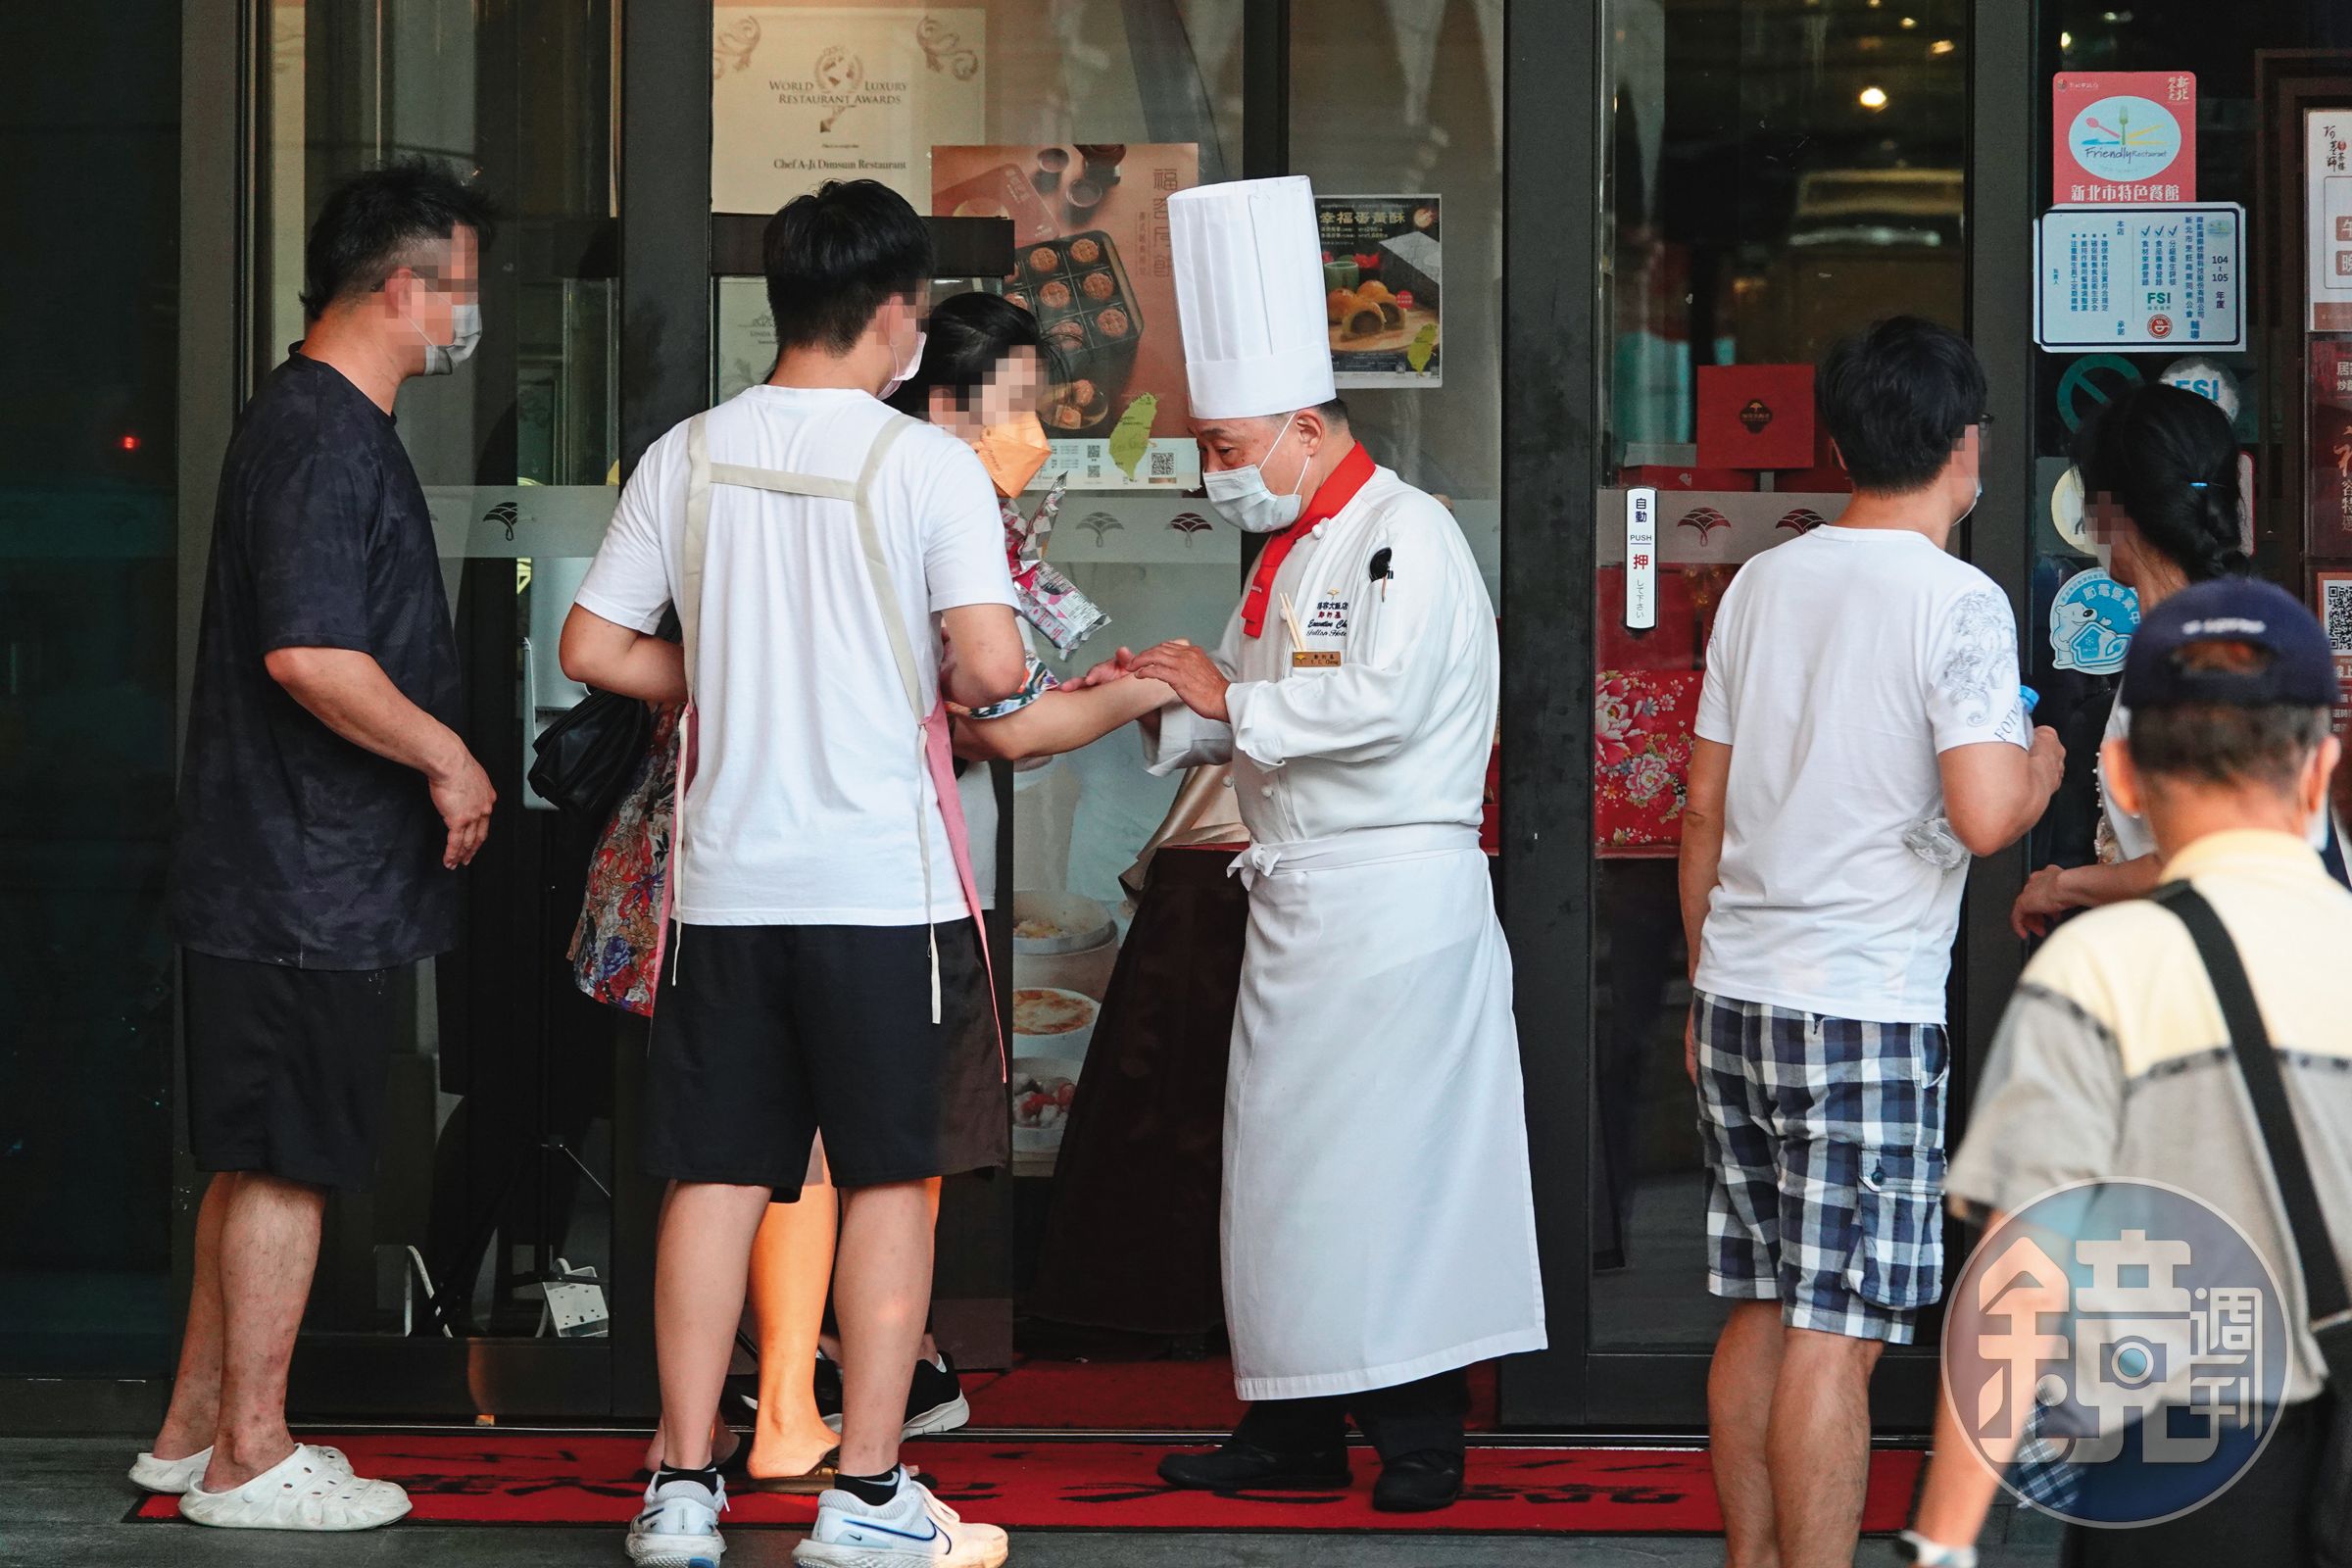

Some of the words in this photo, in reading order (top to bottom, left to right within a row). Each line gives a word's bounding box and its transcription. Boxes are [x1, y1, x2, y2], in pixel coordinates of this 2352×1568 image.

[769, 80, 814, 91] WORLD
[864, 80, 907, 91] LUXURY
[778, 94, 850, 105] RESTAURANT
[855, 94, 902, 105] AWARDS
[2084, 147, 2132, 165] Friendly
[773, 159, 796, 170] Chef
[858, 159, 906, 170] Restaurant
[2071, 184, 2180, 202] 新北市特色餐館
[2212, 256, 2229, 265] 104
[2212, 273, 2229, 282] 105
[2147, 292, 2172, 305] FSI
[2216, 291, 2226, 310] 年度
[2336, 362, 2352, 376] 居
[1635, 498, 1647, 523] 自動
[1633, 554, 1648, 570] 押
